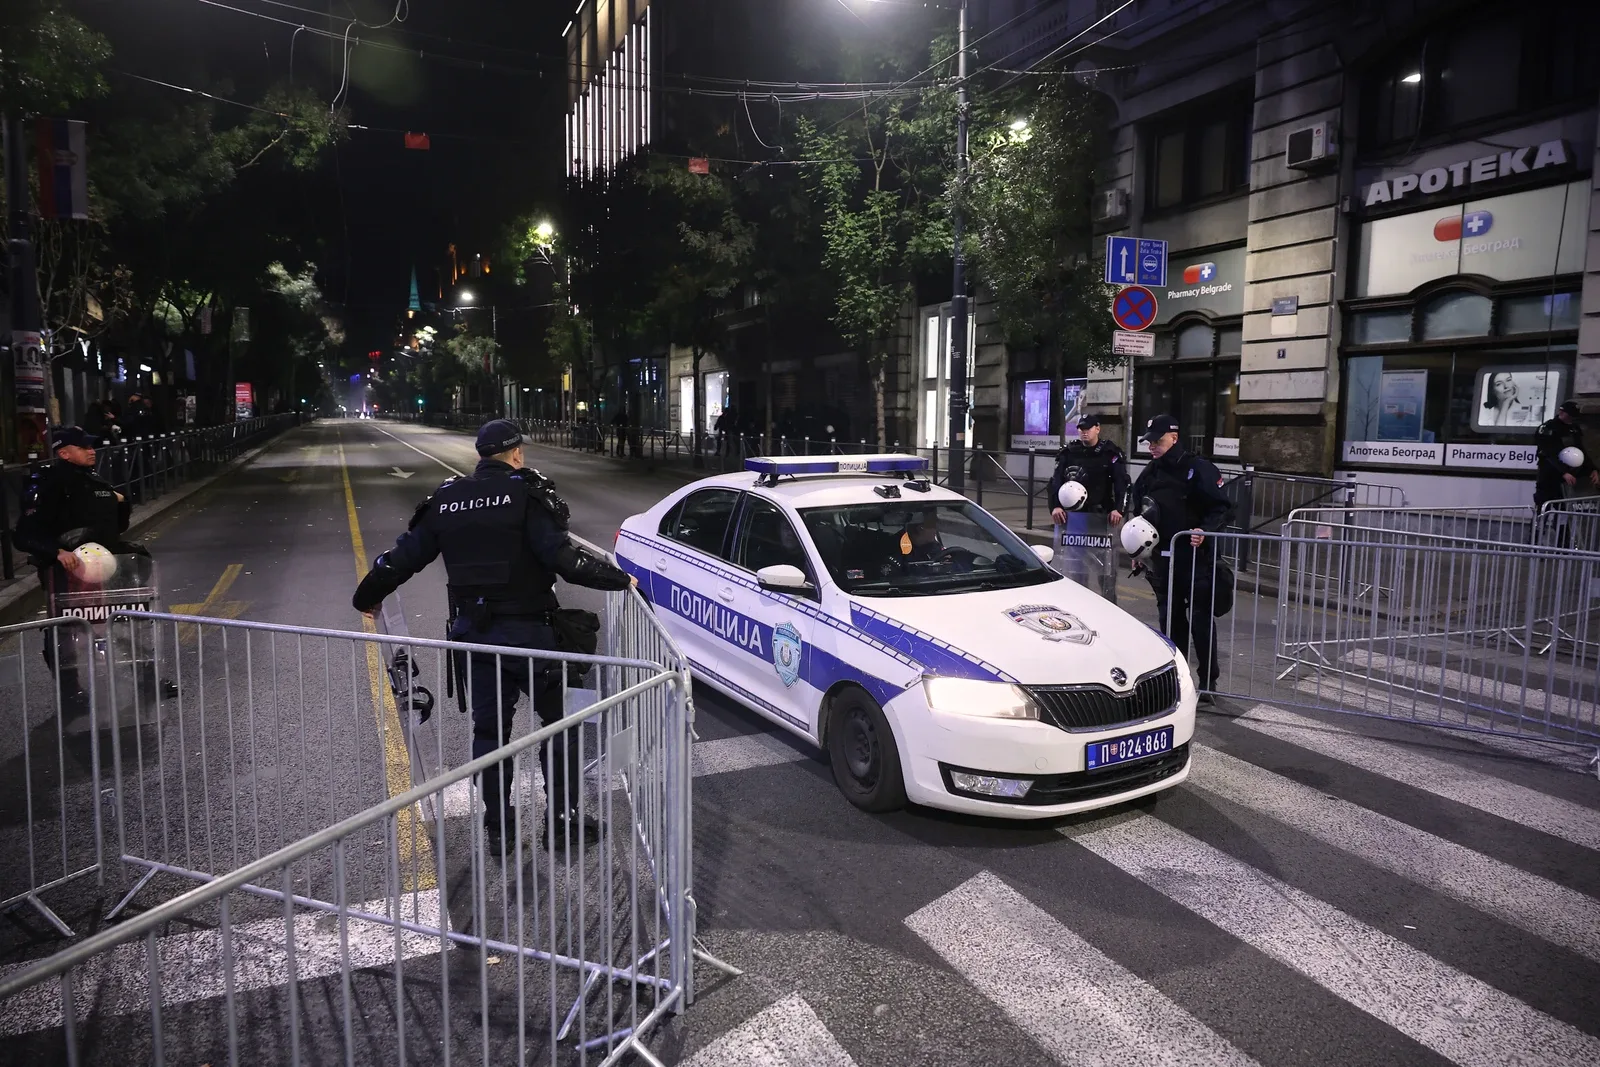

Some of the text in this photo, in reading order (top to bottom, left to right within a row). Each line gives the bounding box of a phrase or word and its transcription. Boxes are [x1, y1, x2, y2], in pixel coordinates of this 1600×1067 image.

[1365, 139, 1567, 206] APOTEKA
[1463, 236, 1519, 256] Београд
[1168, 282, 1232, 299] Pharmacy Belgrade
[1349, 445, 1436, 460] Апотека Београд
[1452, 448, 1506, 463] Pharmacy
[439, 494, 512, 514] POLICIJA
[1062, 535, 1111, 548] ПОЛИЦИЈА
[670, 584, 764, 655] ПОЛИЦИЈА
